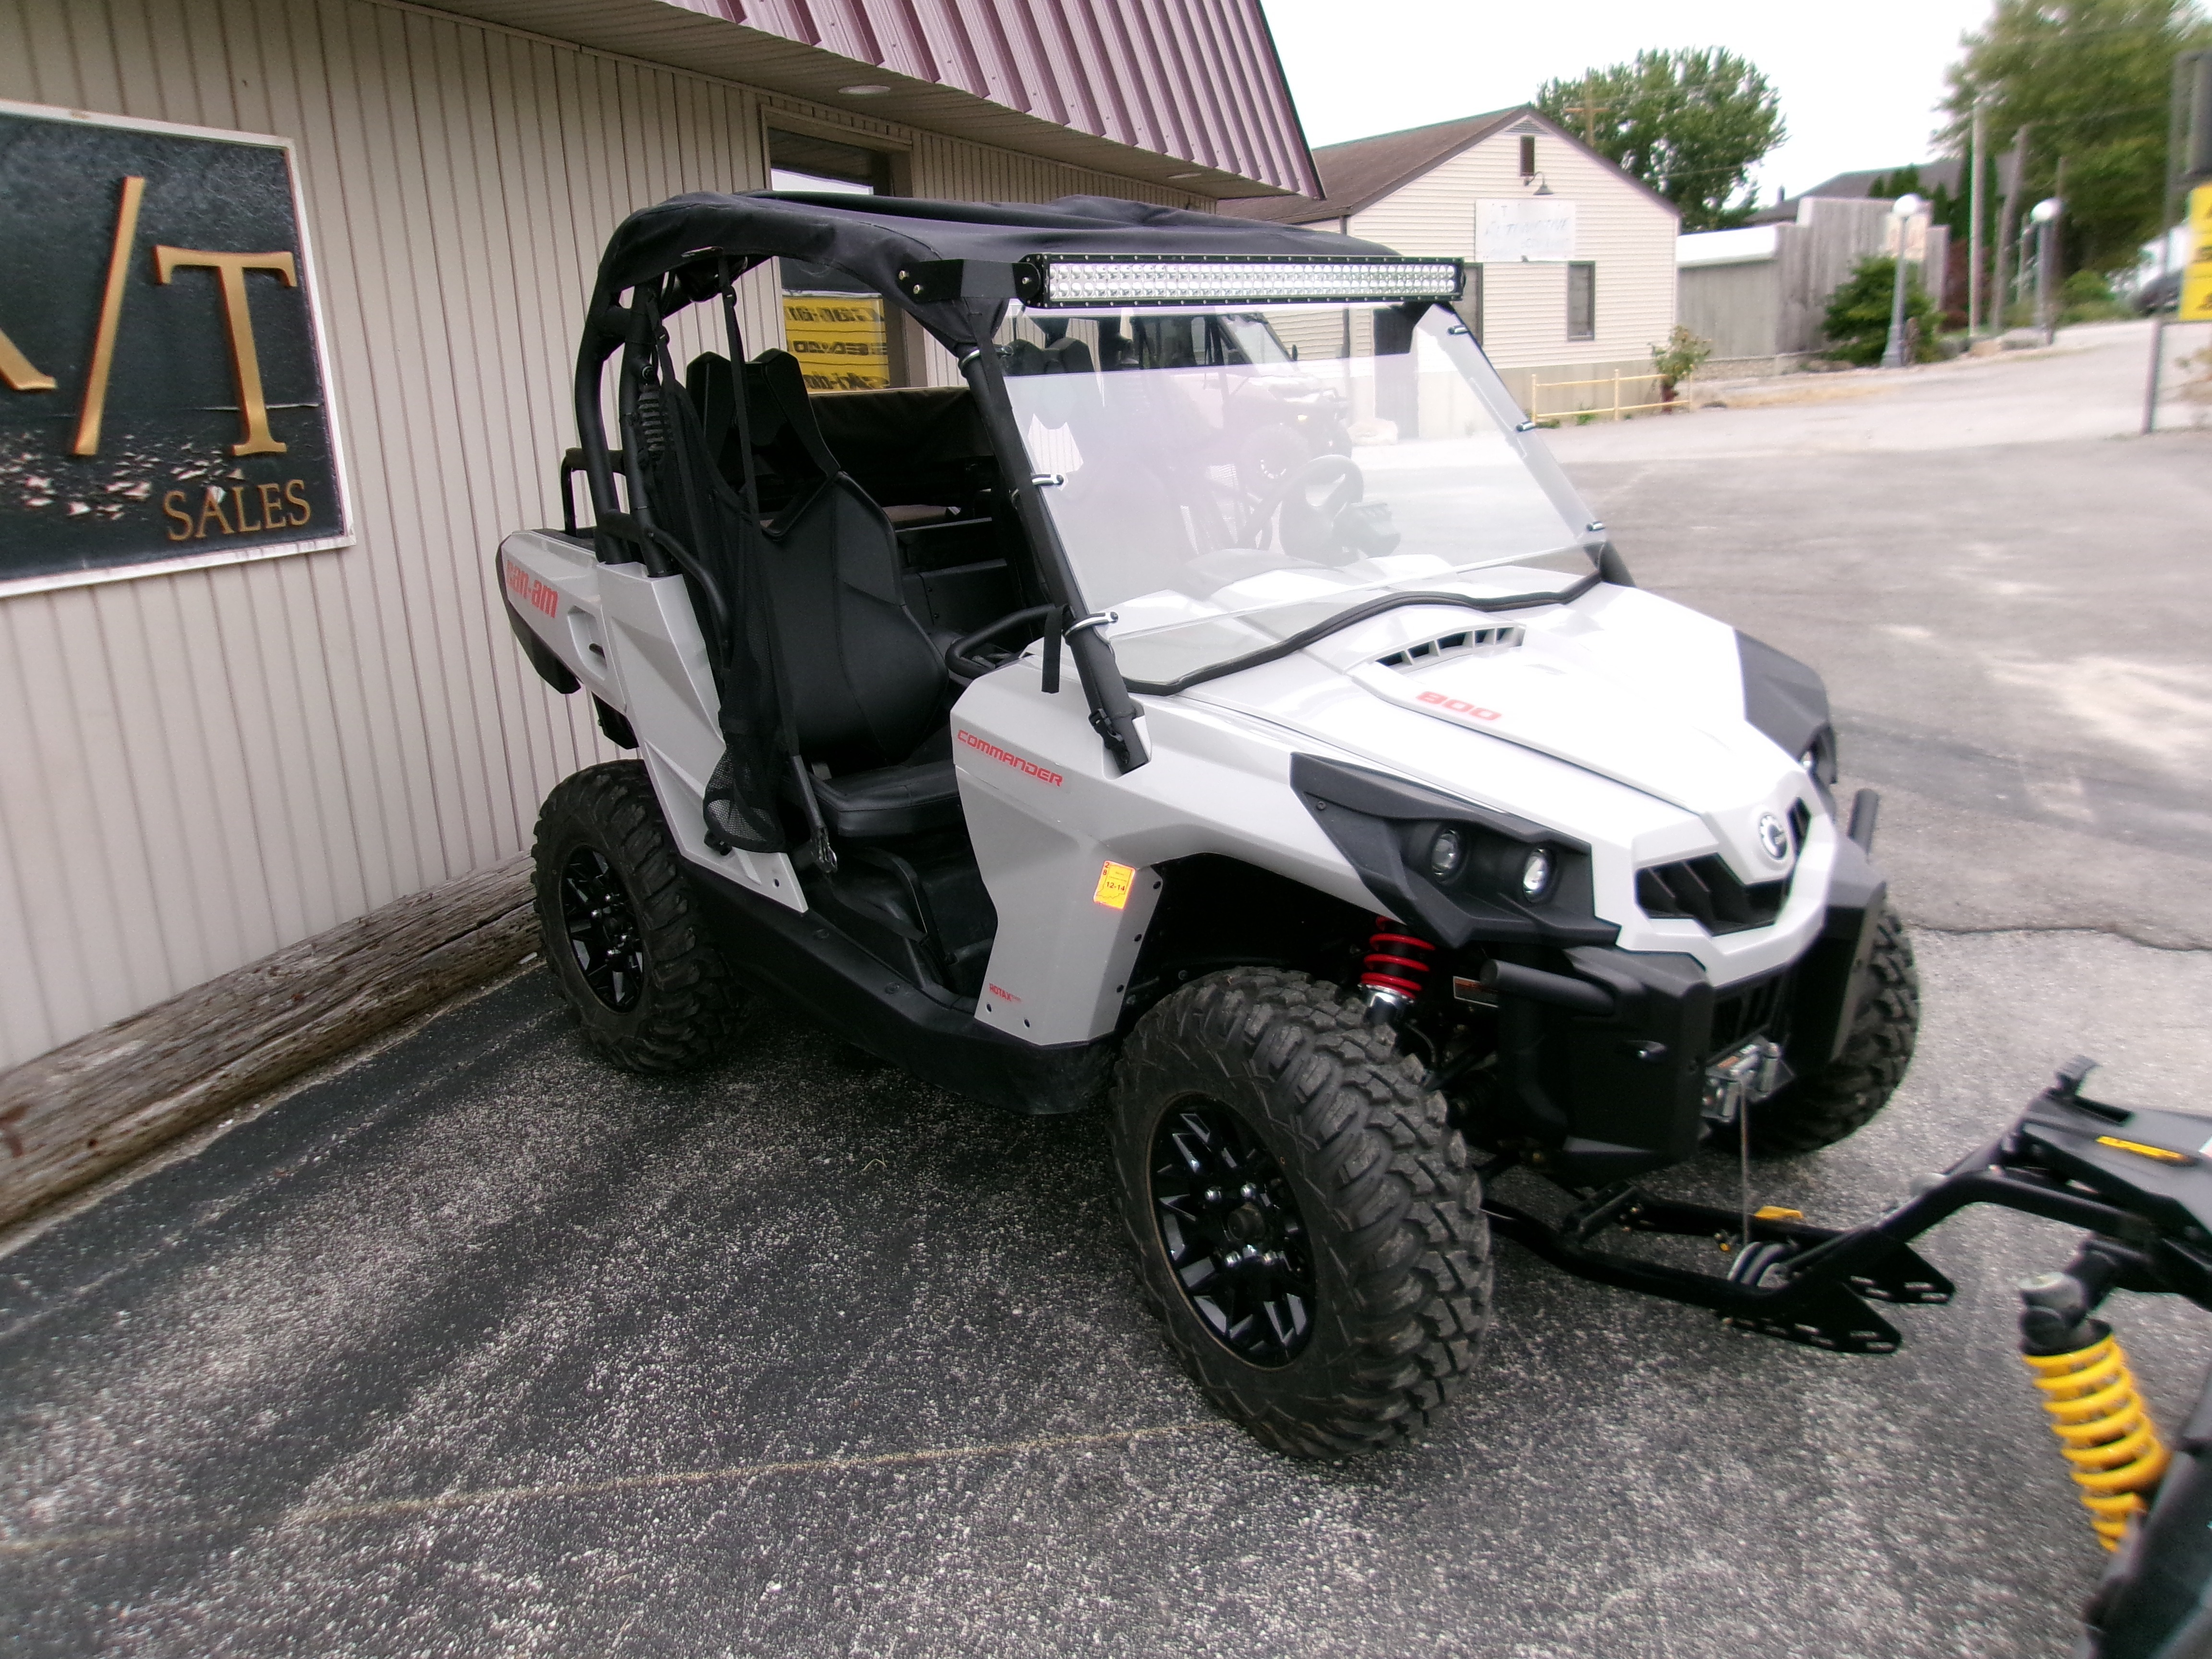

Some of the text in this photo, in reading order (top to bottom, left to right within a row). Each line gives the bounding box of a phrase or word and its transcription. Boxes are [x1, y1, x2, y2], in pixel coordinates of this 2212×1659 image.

[164, 480, 311, 541] SALES
[957, 729, 1063, 787] COMMANDER
[1106, 881, 1125, 891] 12-14
